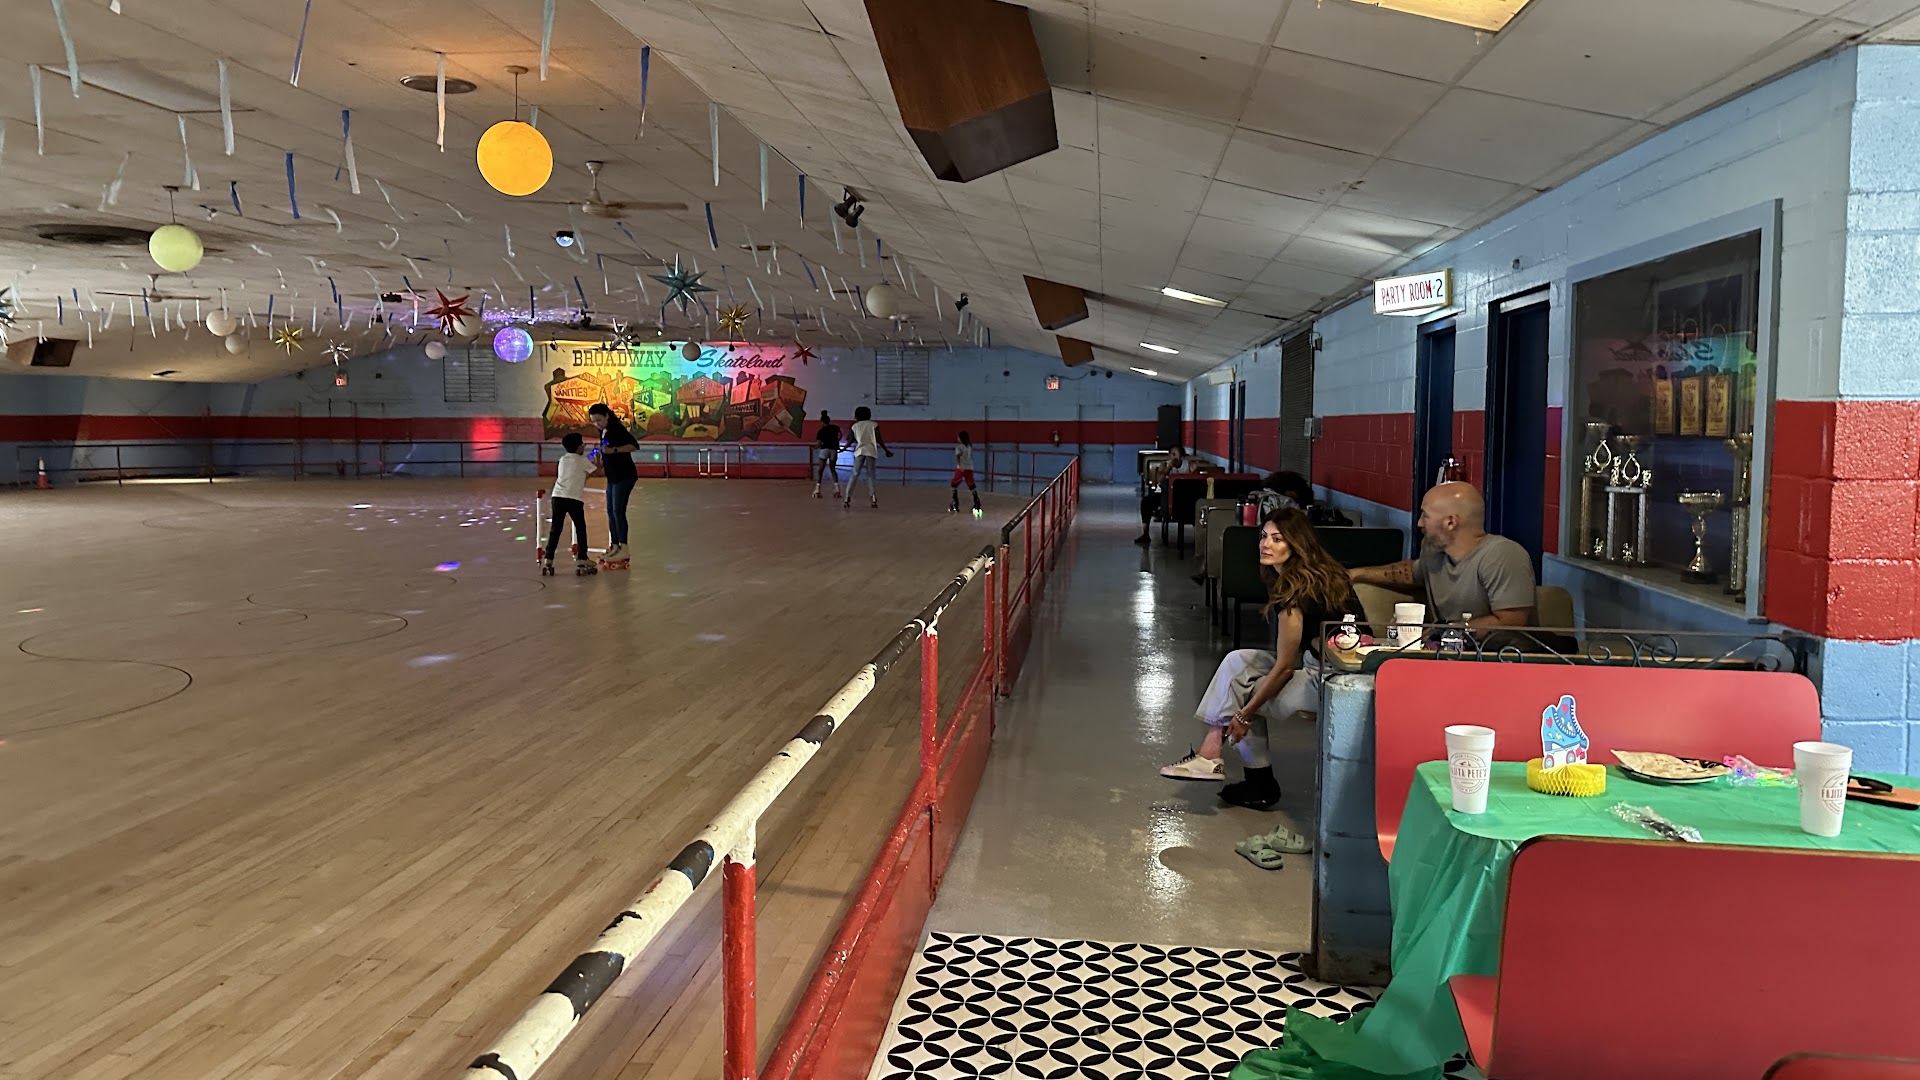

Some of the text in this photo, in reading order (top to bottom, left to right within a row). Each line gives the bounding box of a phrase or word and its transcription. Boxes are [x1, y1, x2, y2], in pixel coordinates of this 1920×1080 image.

[1381, 284, 1406, 306] PARTY
[572, 348, 786, 368] BROADWAY Skateland
[554, 387, 588, 398] VANITIES
